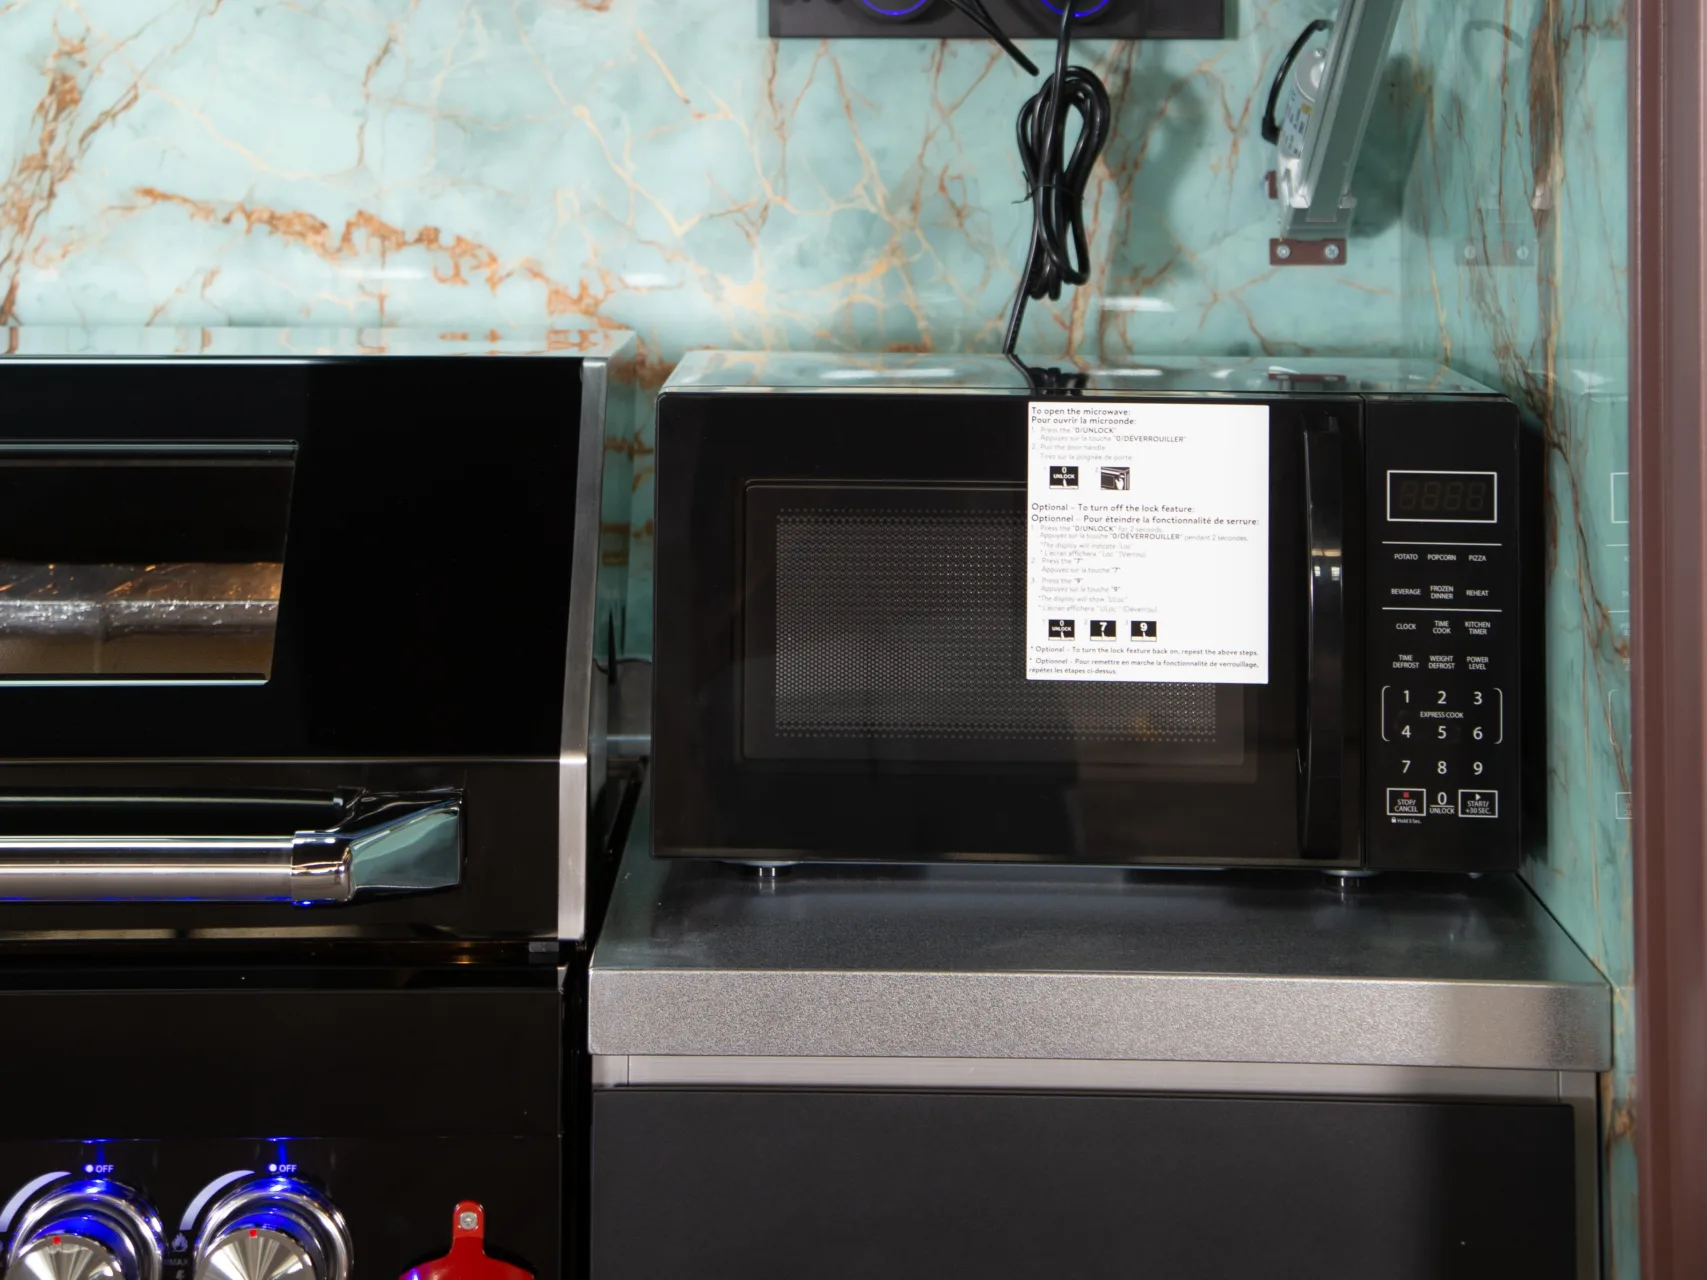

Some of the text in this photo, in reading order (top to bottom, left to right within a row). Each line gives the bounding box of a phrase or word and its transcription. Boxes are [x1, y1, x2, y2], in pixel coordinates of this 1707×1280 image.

[1032, 406, 1130, 417] To open the microwave:
[1031, 416, 1051, 424] Pour
[1080, 416, 1087, 424] la
[1090, 417, 1137, 425] microonde:
[1031, 503, 1068, 513] Optional
[1079, 504, 1088, 512] To
[1110, 504, 1123, 512] off
[1125, 504, 1139, 512] the
[1141, 505, 1159, 513] lock
[1161, 505, 1195, 513] feature:
[1031, 514, 1073, 524] Optionnel
[1083, 515, 1103, 523] Pour
[1105, 515, 1140, 524] éteindre
[1143, 516, 1150, 524] la
[1152, 516, 1211, 525] fonctionnalité
[1213, 517, 1224, 525] de
[1100, 622, 1107, 631] 7
[1140, 622, 1147, 631] 9
[1035, 646, 1065, 654] Optional
[1181, 649, 1203, 658] repeat
[1036, 658, 1068, 666] Optionnel
[1403, 690, 1410, 703] 1
[1437, 690, 1447, 704] 2
[1474, 691, 1483, 705] 3
[1401, 725, 1411, 738] 4
[1437, 726, 1447, 739] 5
[1473, 727, 1483, 740] 6
[1402, 760, 1411, 773] 7
[1437, 761, 1447, 774] 8
[1473, 762, 1483, 775] 9
[1437, 792, 1447, 805] 0
[95, 1165, 114, 1173] OFF
[279, 1164, 297, 1172] OFF
